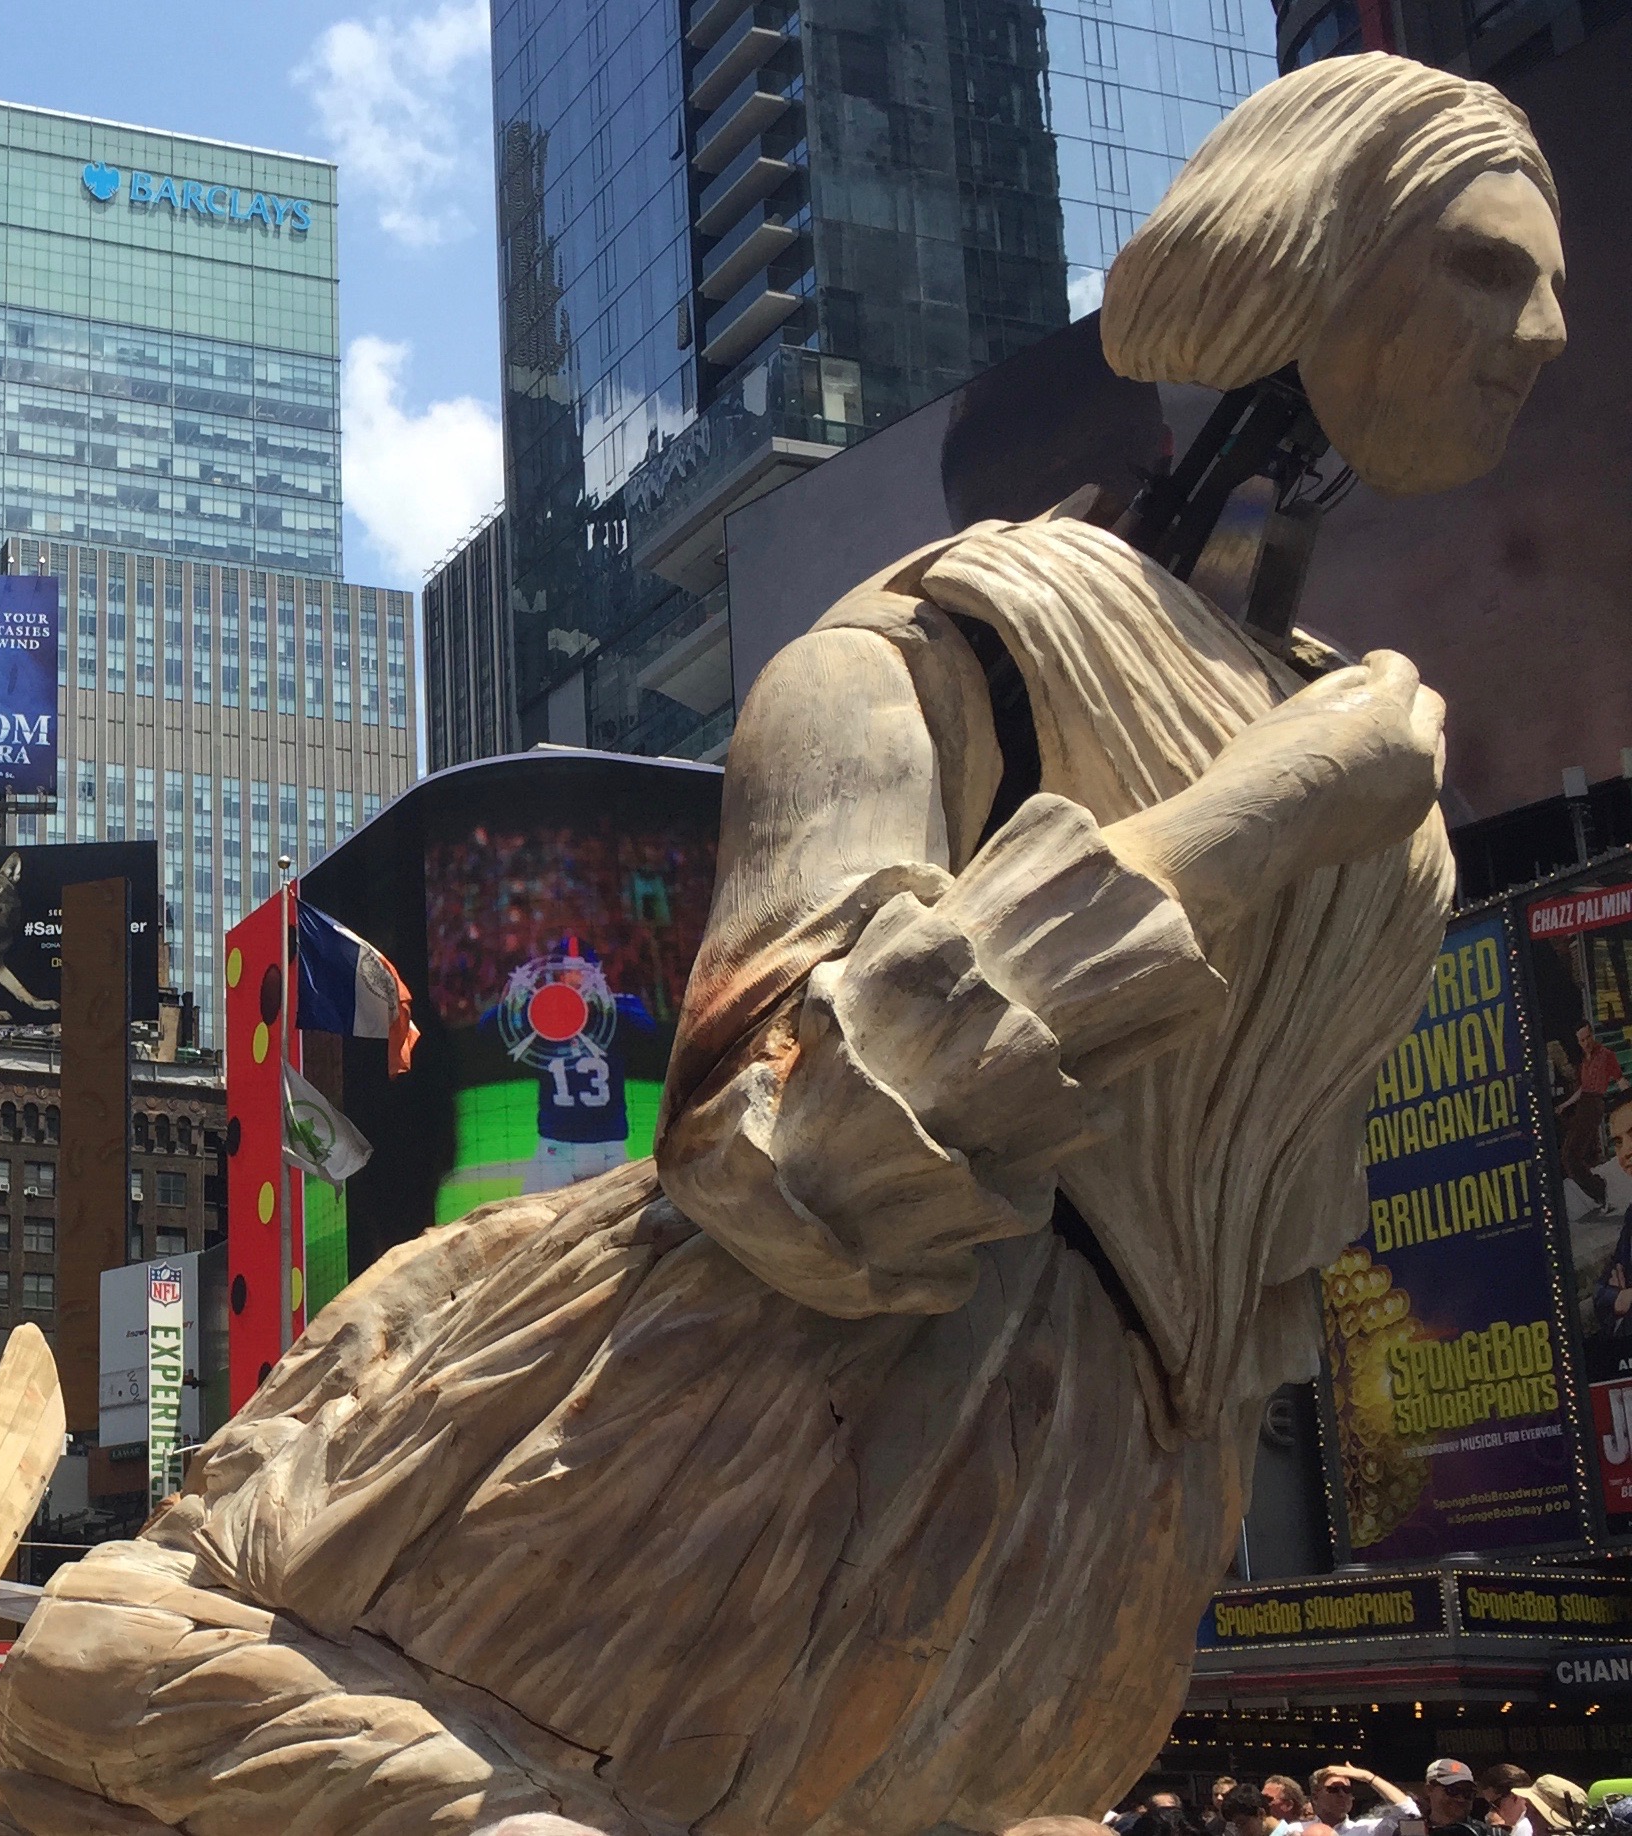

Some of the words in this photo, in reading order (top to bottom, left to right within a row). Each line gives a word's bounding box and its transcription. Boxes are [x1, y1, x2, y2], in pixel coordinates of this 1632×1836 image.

[130, 171, 313, 230] BARCLAYS
[4, 612, 49, 624] YOUR
[24, 921, 62, 936] #Sav
[1532, 903, 1574, 932] CHAZZ
[1577, 889, 1632, 925] PALMIN
[1371, 1003, 1506, 1107] ADWAY
[548, 1056, 611, 1107] 13
[152, 1282, 179, 1301] NFL
[1390, 1320, 1553, 1396] SPONGEBOB
[150, 1324, 183, 1499] EXPERIENC
[1395, 1373, 1559, 1434] SQUAREPANTS
[1460, 1432, 1504, 1452] MUSICAL
[1504, 1431, 1520, 1443] FOR
[1520, 1424, 1563, 1442] EVERYONE
[1215, 1599, 1303, 1637] SPONGEBOB
[1304, 1591, 1415, 1630] SQUAREPANTS
[1466, 1586, 1558, 1622] SPONGEBOB
[1556, 1658, 1632, 1684] CHAN
